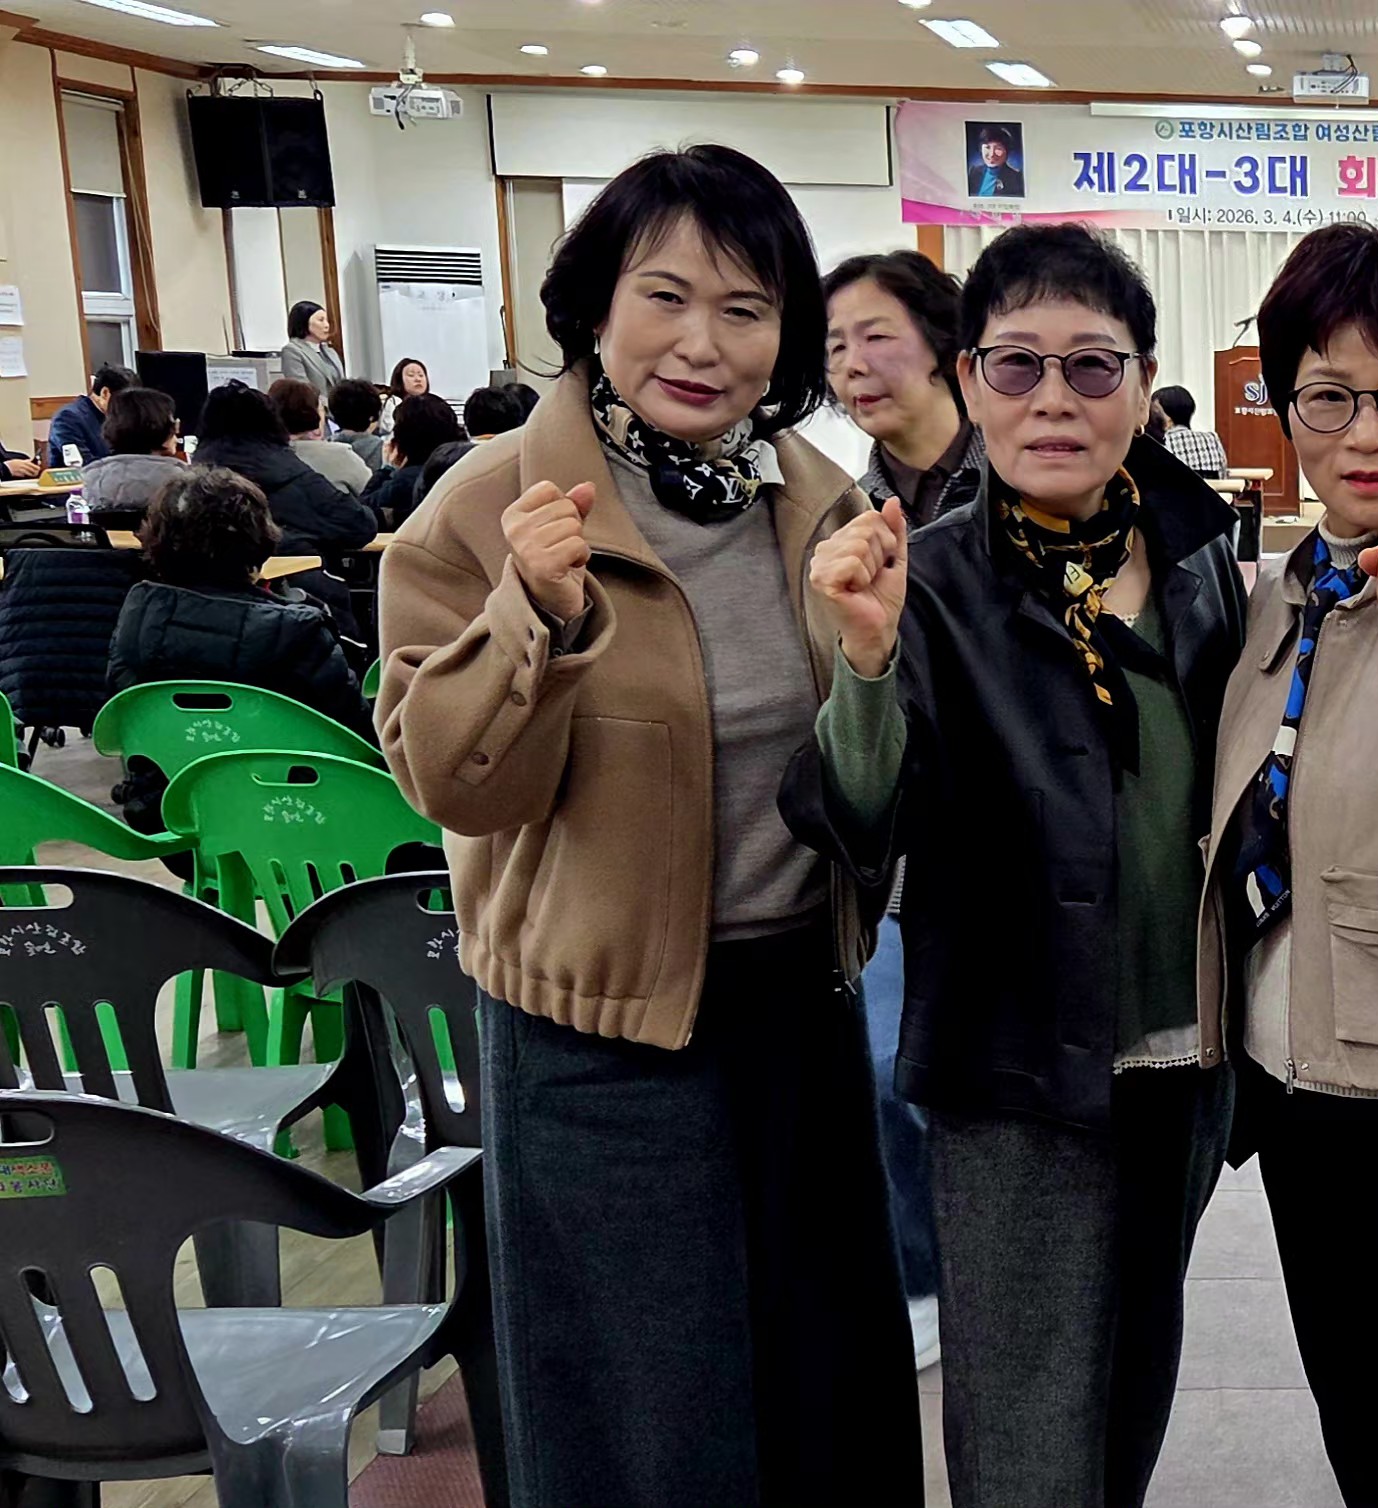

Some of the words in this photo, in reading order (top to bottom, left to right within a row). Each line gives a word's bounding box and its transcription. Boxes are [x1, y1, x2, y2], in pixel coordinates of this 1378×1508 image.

[1178, 120, 1309, 142] 포항시산림조합
[1072, 151, 1310, 198] 제2대-3대
[1176, 206, 1212, 224] 일시:
[1216, 208, 1259, 225] 2026.
